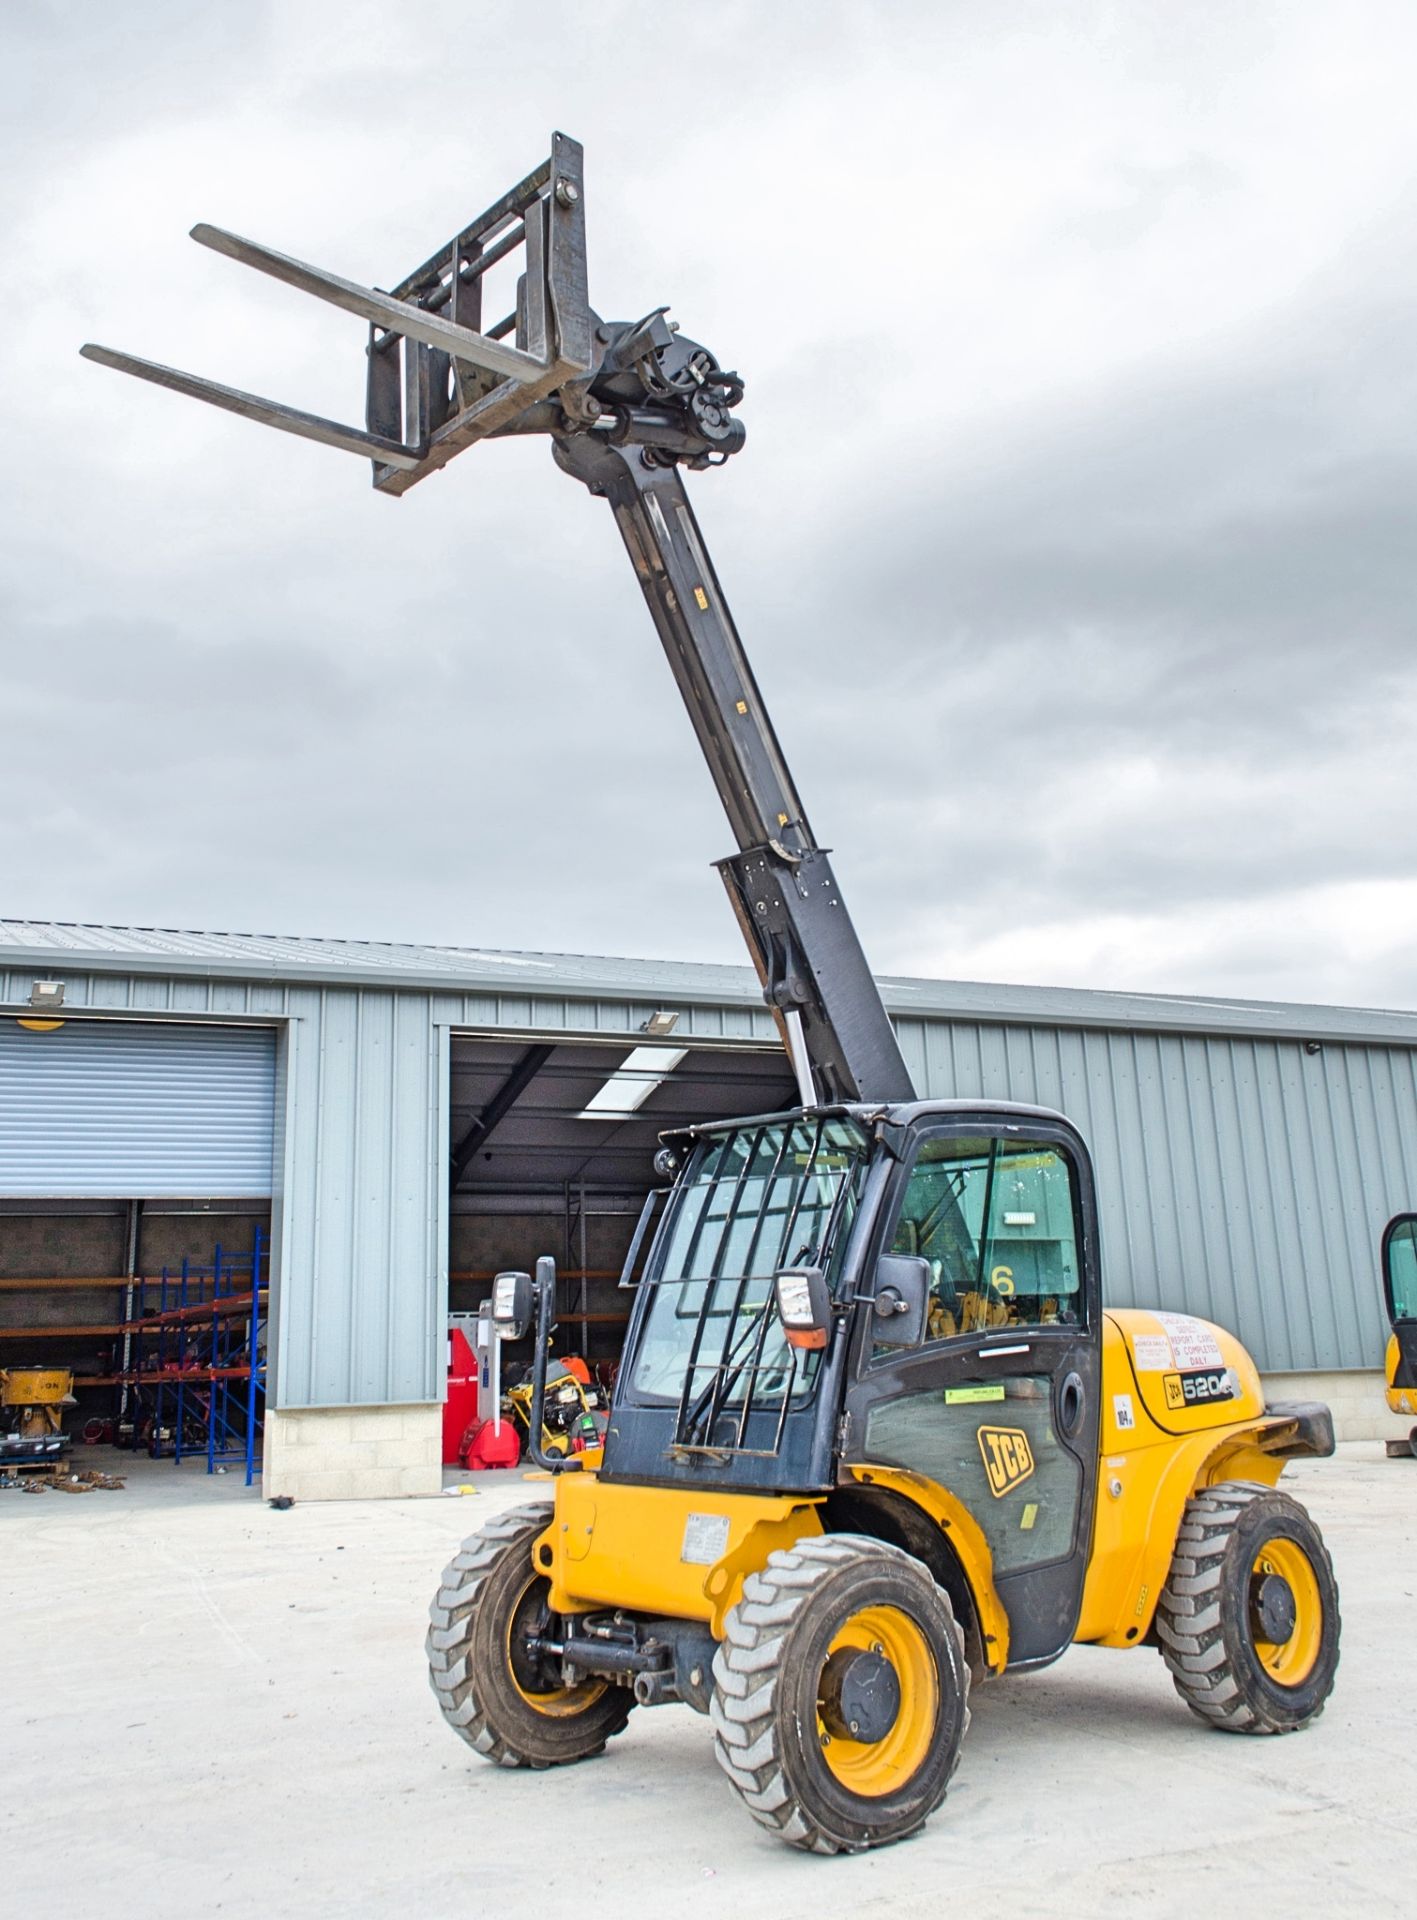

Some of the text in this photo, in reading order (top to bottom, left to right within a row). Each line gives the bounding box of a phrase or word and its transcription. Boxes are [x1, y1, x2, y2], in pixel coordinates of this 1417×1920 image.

[992, 1265, 1015, 1296] 6
[1170, 1334, 1214, 1346] REPORT CARD
[1173, 1344, 1218, 1356] IS COMPLETED
[1189, 1356, 1207, 1367] DAILY
[986, 1433, 1030, 1489] JCB
